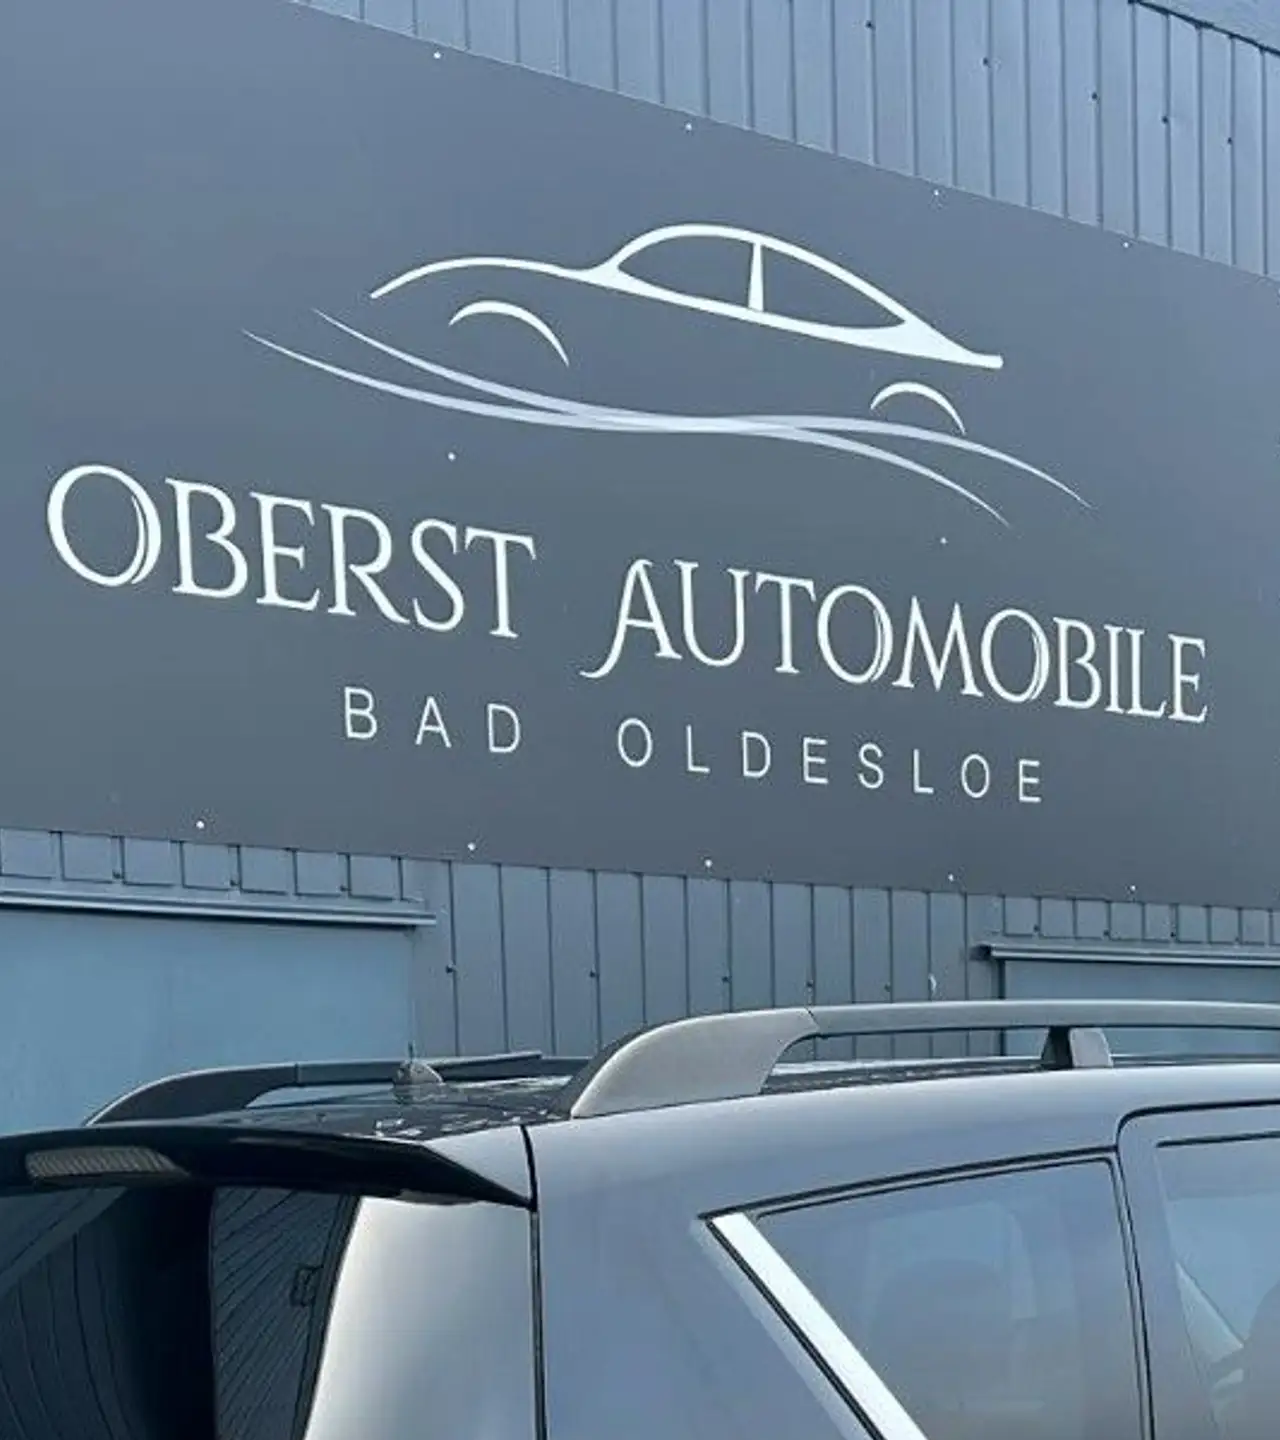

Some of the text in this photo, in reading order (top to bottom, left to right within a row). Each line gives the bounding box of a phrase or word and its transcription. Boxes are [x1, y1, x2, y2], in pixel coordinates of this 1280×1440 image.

[46, 463, 1209, 725] OBERST AUTOMOBILE
[343, 685, 1042, 804] BAD OLDESLOE
